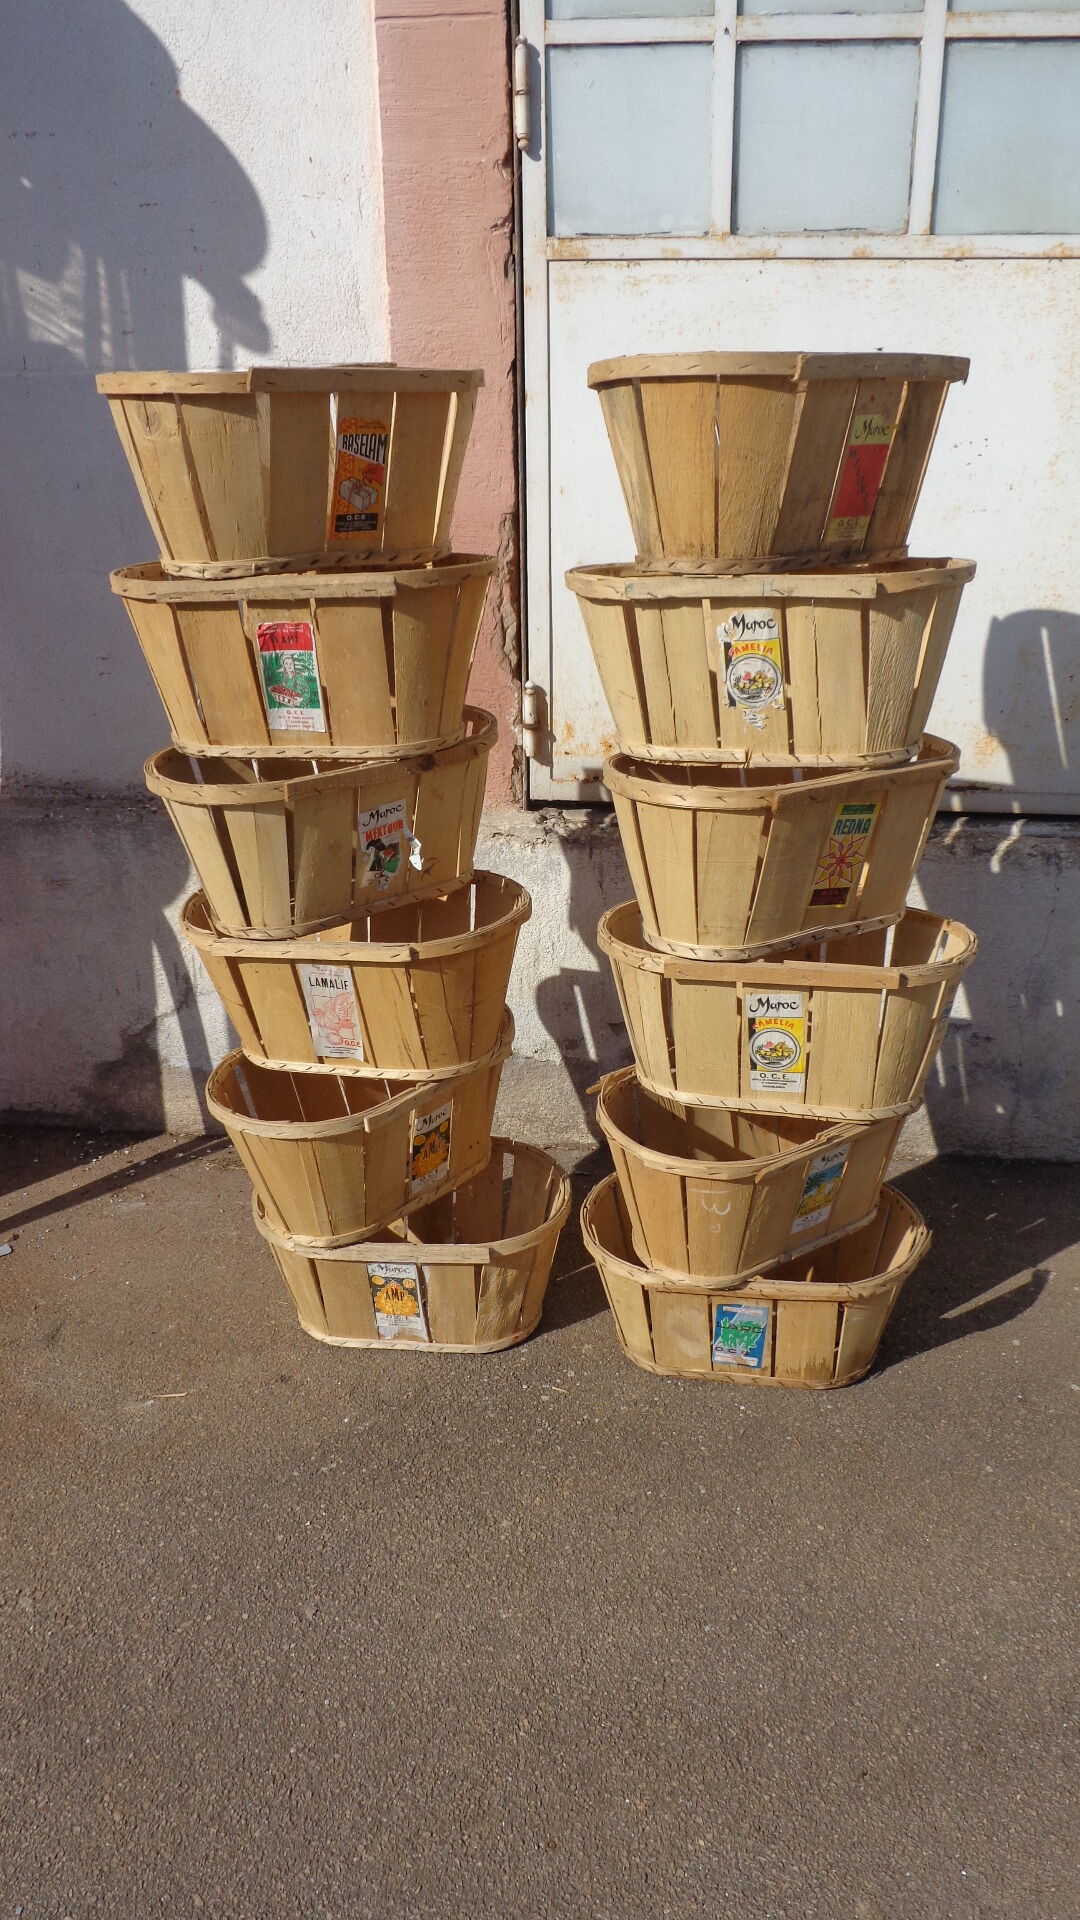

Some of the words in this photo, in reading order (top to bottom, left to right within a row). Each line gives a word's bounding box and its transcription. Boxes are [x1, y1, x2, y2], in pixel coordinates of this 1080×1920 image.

[855, 418, 889, 440] Maroc
[724, 613, 776, 640] Maroc
[363, 804, 403, 827] Maroc
[833, 818, 872, 835] REDNA
[309, 977, 349, 991] LAMALIF
[750, 996, 799, 1016] Maroc
[752, 1018, 795, 1030] CAMELIA
